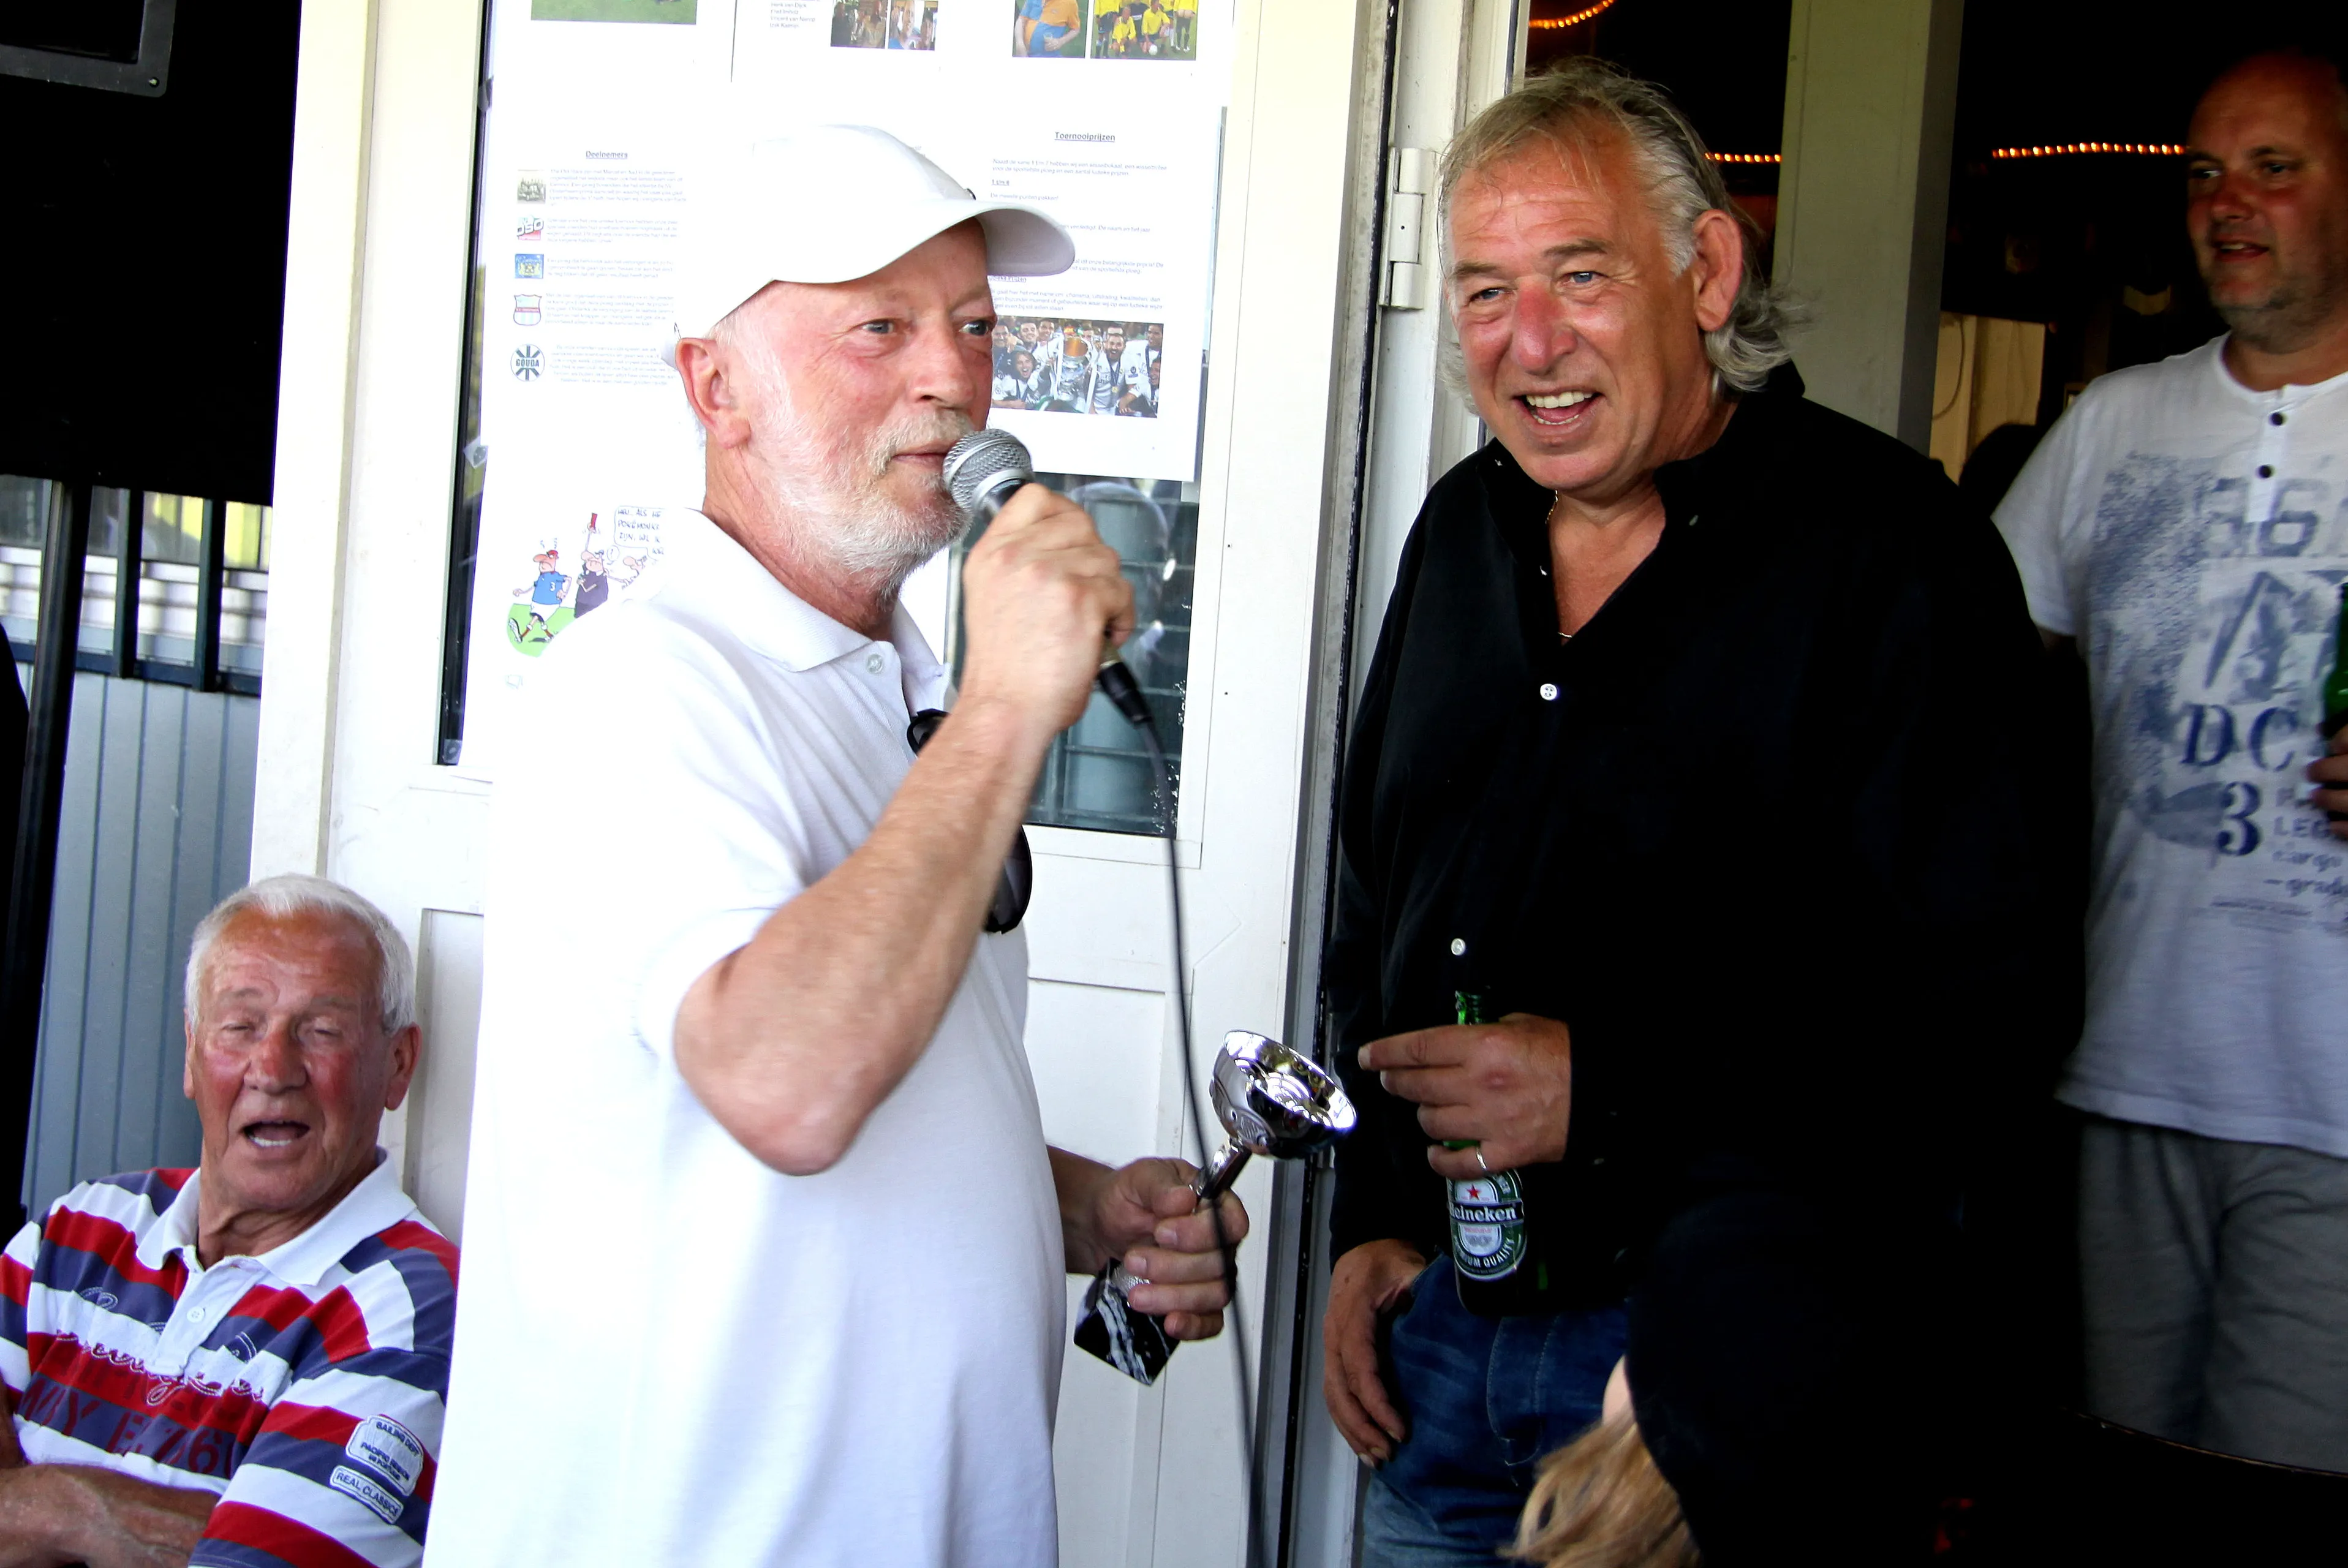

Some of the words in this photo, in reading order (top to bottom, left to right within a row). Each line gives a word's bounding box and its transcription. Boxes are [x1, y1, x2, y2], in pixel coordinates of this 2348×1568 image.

[585, 150, 628, 159] Deelnemers
[516, 358, 540, 368] GOUDA
[2215, 780, 2261, 856] 3
[1482, 1237, 1515, 1268] QUALITY
[337, 1472, 361, 1490] REAL
[363, 1485, 399, 1517] CLASSICS
